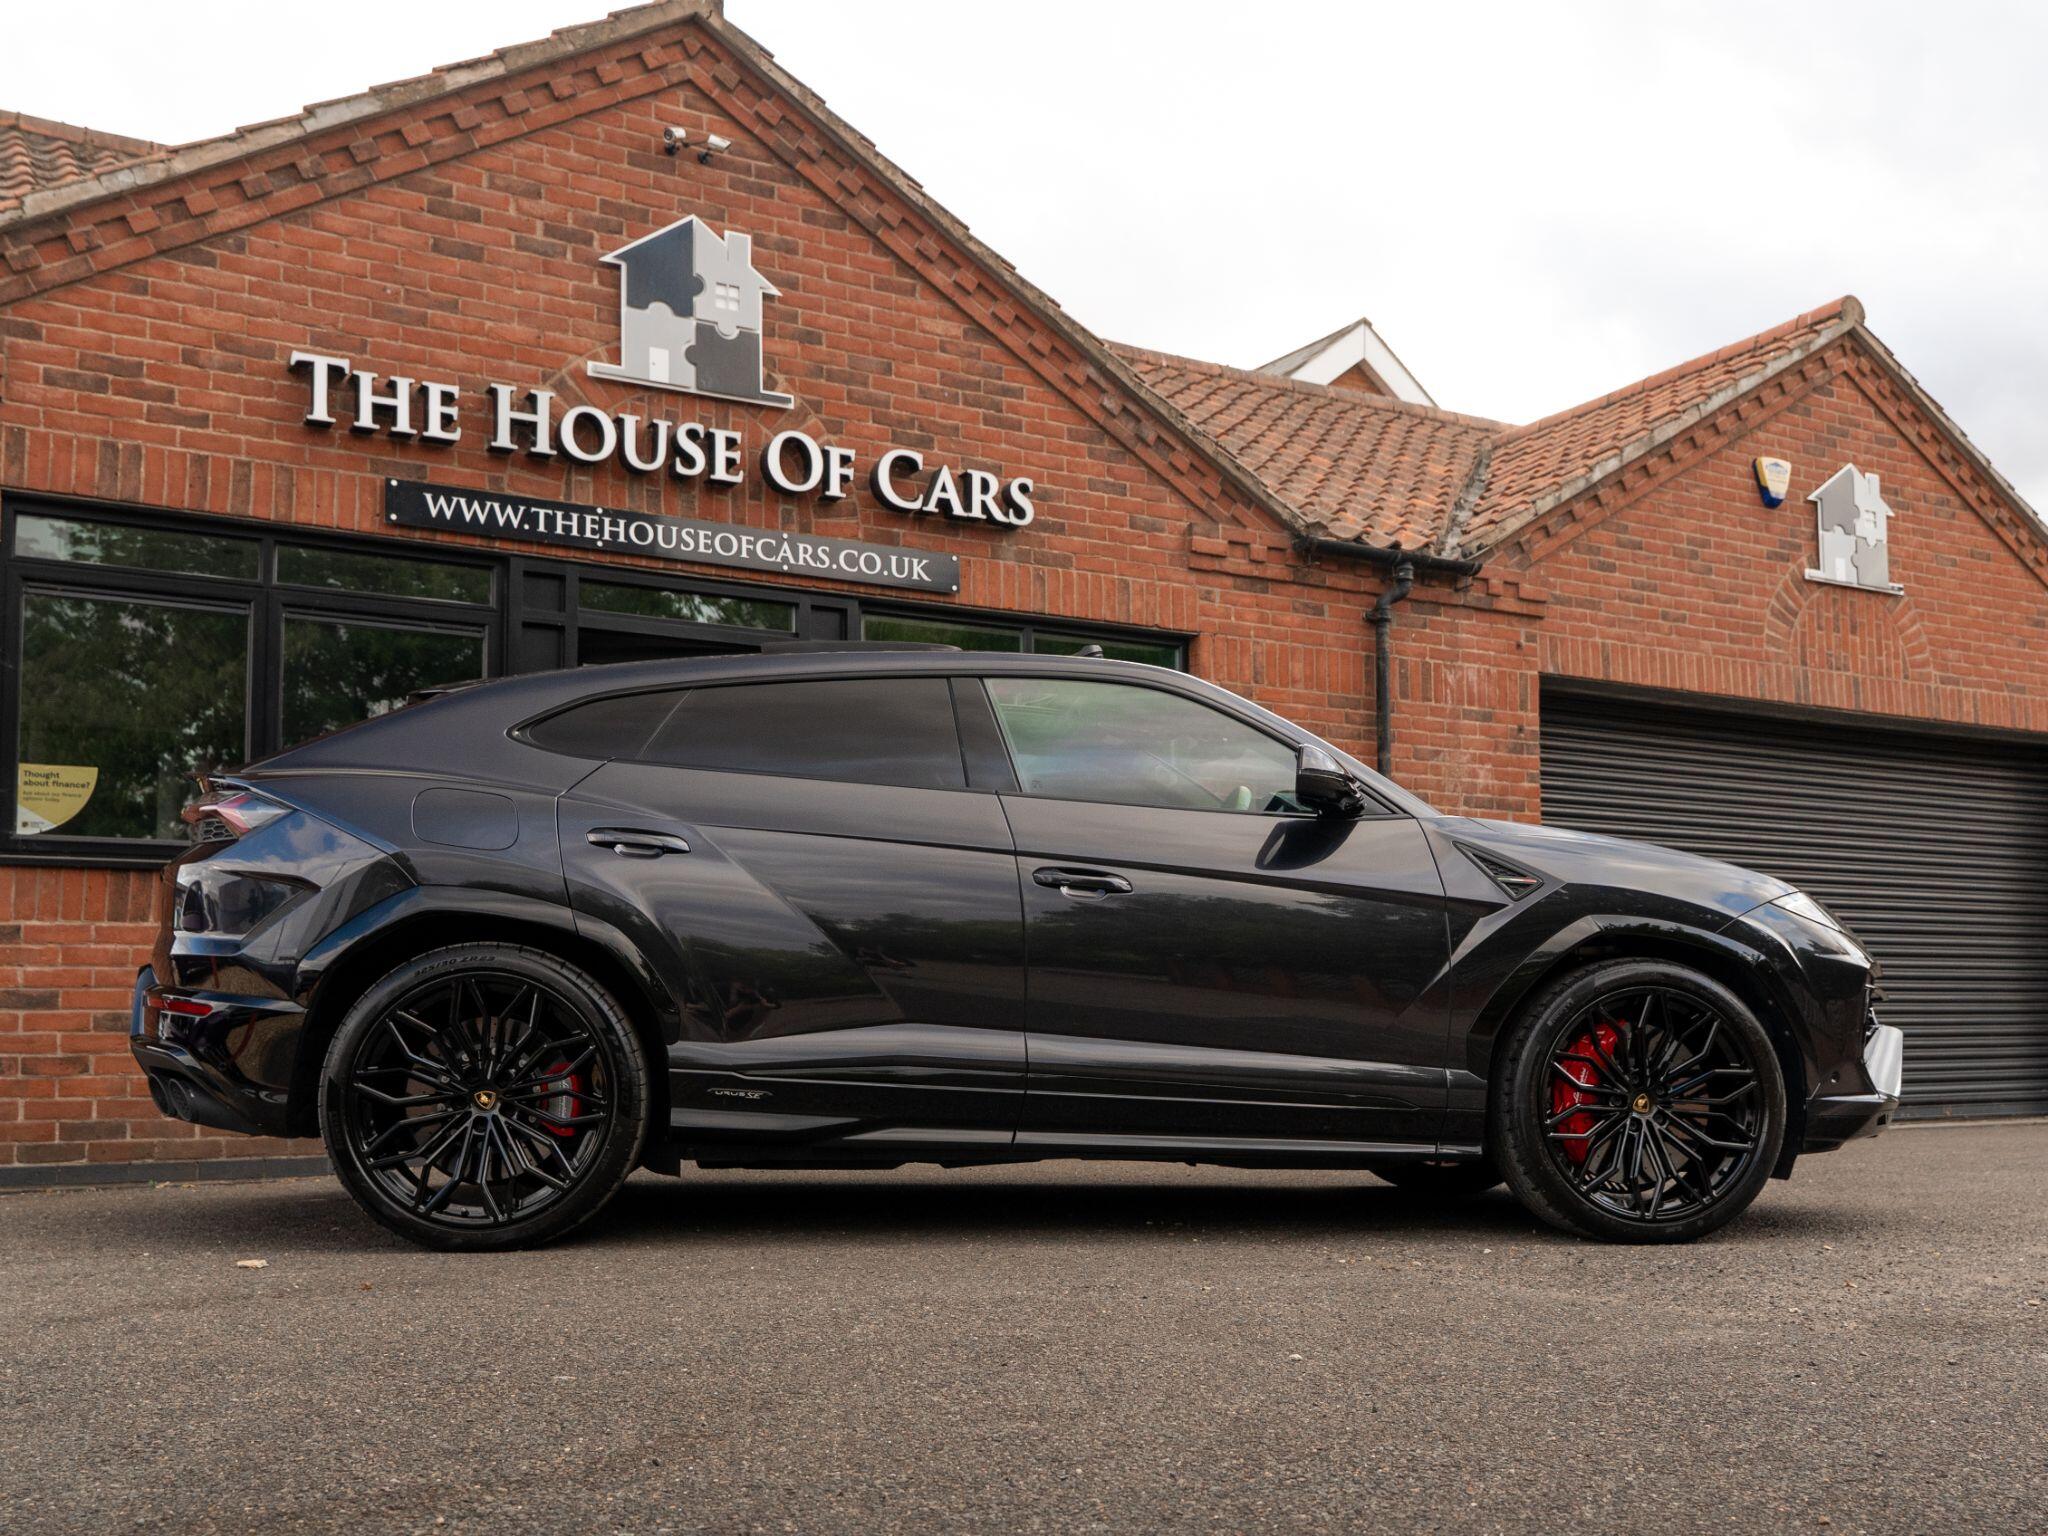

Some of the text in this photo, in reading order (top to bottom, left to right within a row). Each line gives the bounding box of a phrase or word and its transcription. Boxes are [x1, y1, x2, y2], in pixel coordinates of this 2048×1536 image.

[289, 350, 1036, 527] THE HOUSE OF CARS
[424, 493, 932, 582] WWW.THEHOUSEOFCARS.CO.UK
[23, 779, 90, 789] about finance?
[24, 770, 60, 779] Thought
